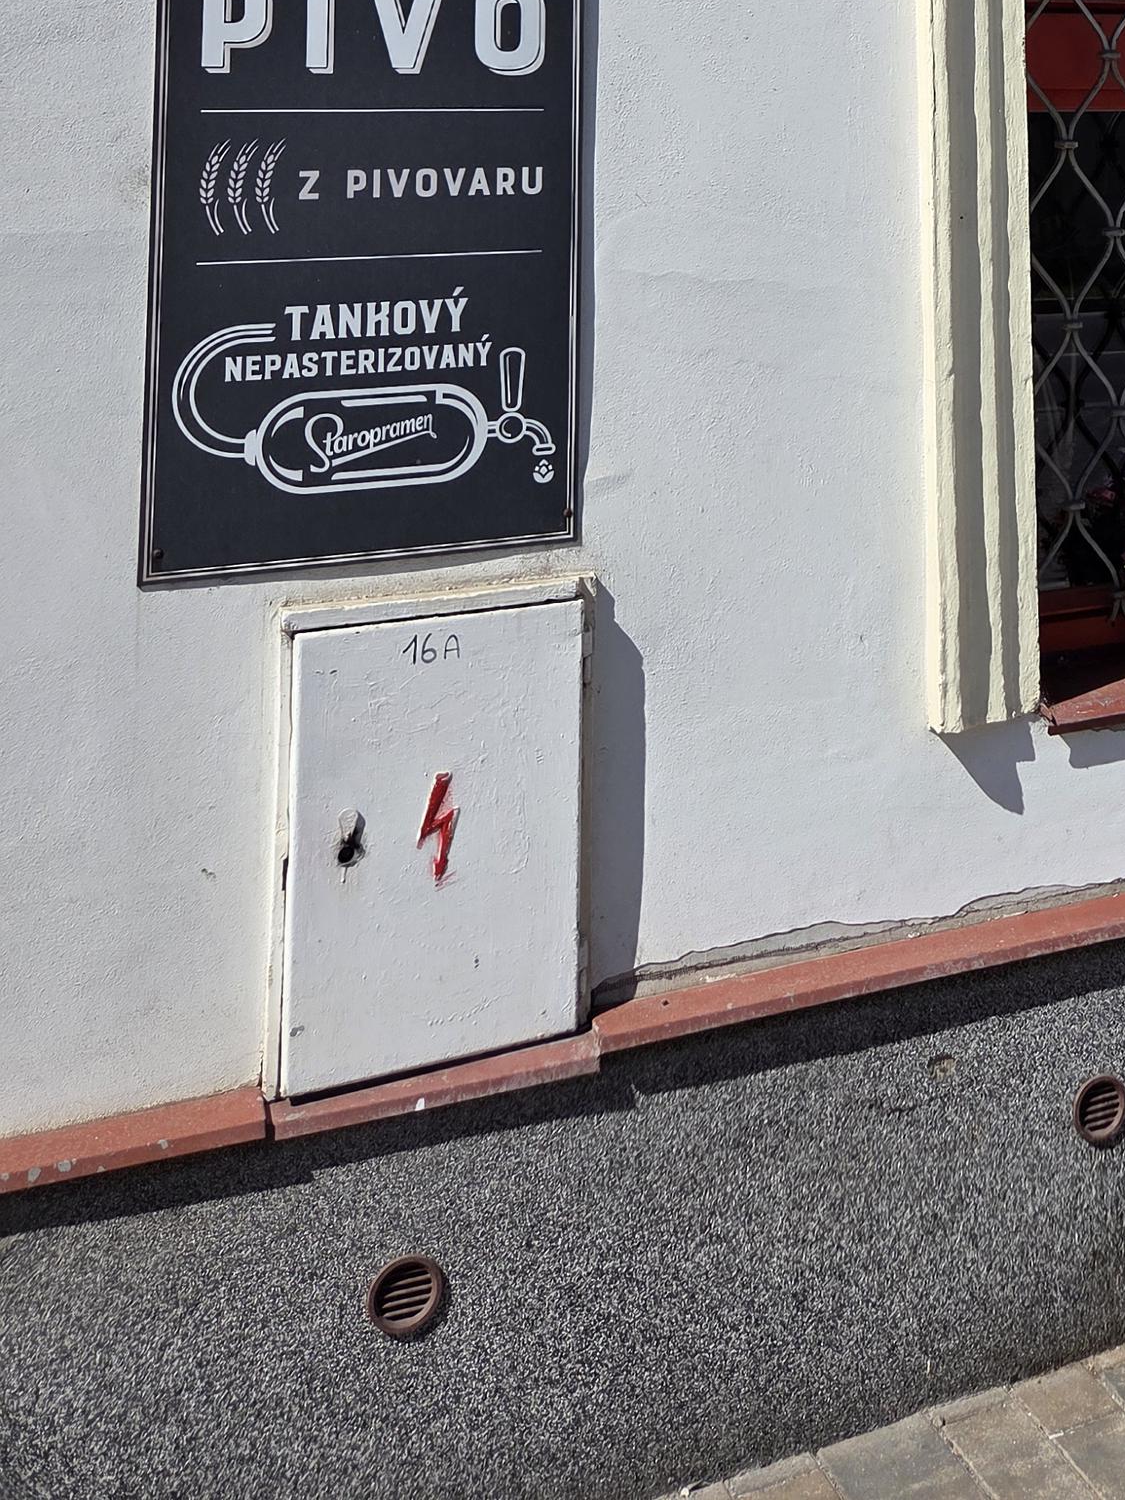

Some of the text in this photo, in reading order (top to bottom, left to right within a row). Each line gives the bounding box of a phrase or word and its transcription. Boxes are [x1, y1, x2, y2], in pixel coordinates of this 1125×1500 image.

[298, 166, 544, 200] Z PIVOVARU
[284, 286, 469, 342] TANKOVÝ
[224, 334, 492, 383] NEPASTERIZOVANÝ
[304, 411, 437, 474] Staropramen
